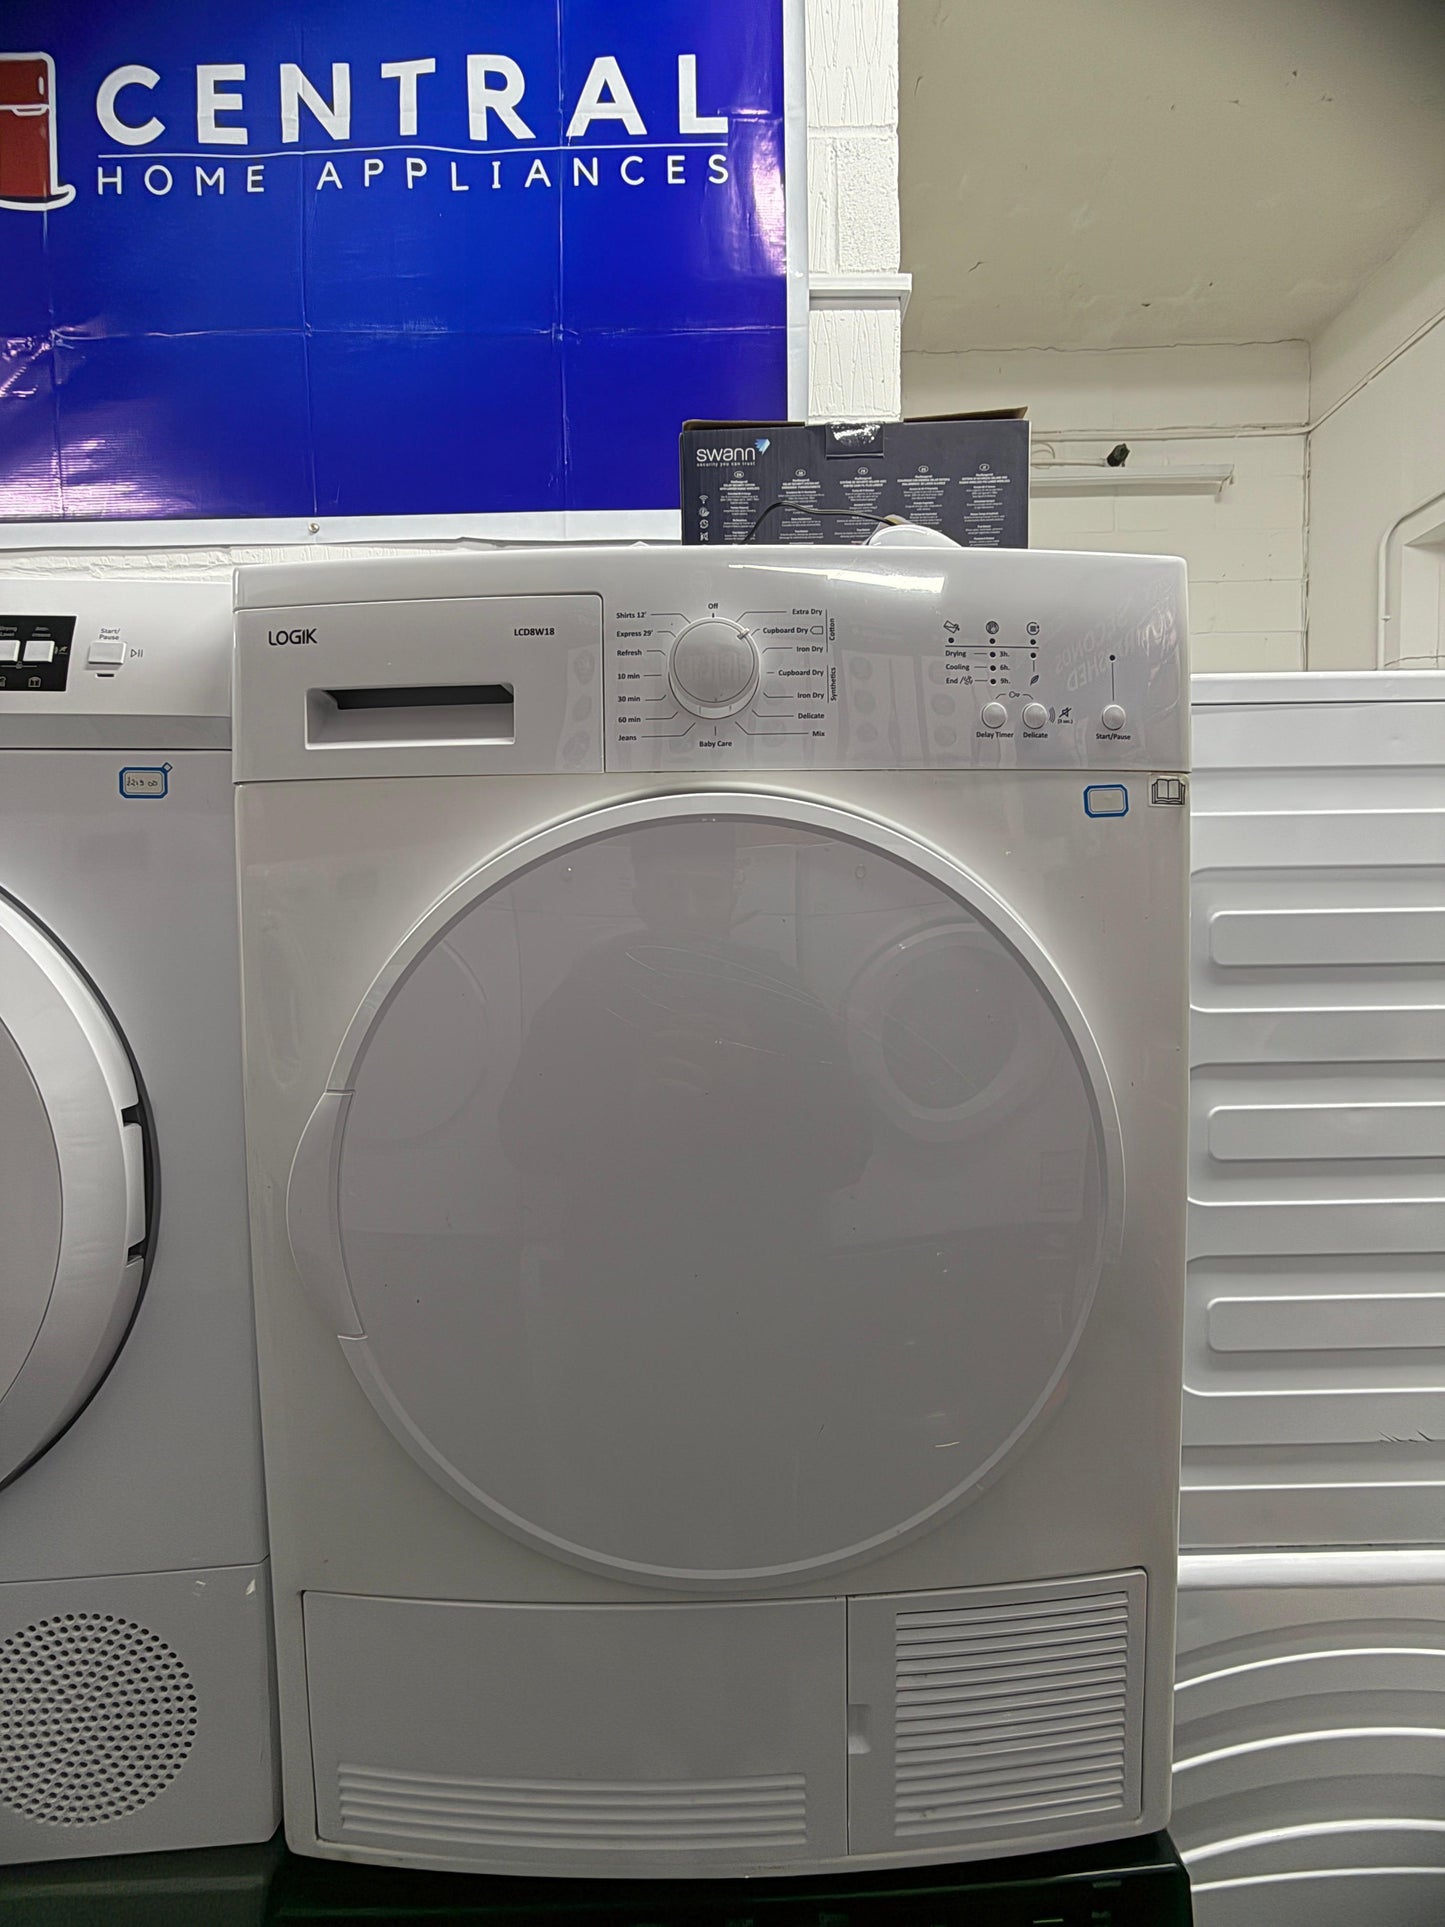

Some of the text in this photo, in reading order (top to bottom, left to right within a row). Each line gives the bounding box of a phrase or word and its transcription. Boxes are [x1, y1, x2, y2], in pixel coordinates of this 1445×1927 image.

[95, 54, 729, 146] CENTRAL
[97, 154, 729, 196] HOME APPLIANCES
[696, 447, 756, 462] swann
[514, 627, 555, 637] LCD8W18
[797, 627, 808, 635] Dry
[268, 628, 318, 646] LOGIK
[812, 646, 823, 654] Dry
[945, 650, 966, 658] Drying
[812, 692, 824, 700] Dry
[976, 731, 994, 739] Delay
[1096, 732, 1131, 741] Start/Pause
